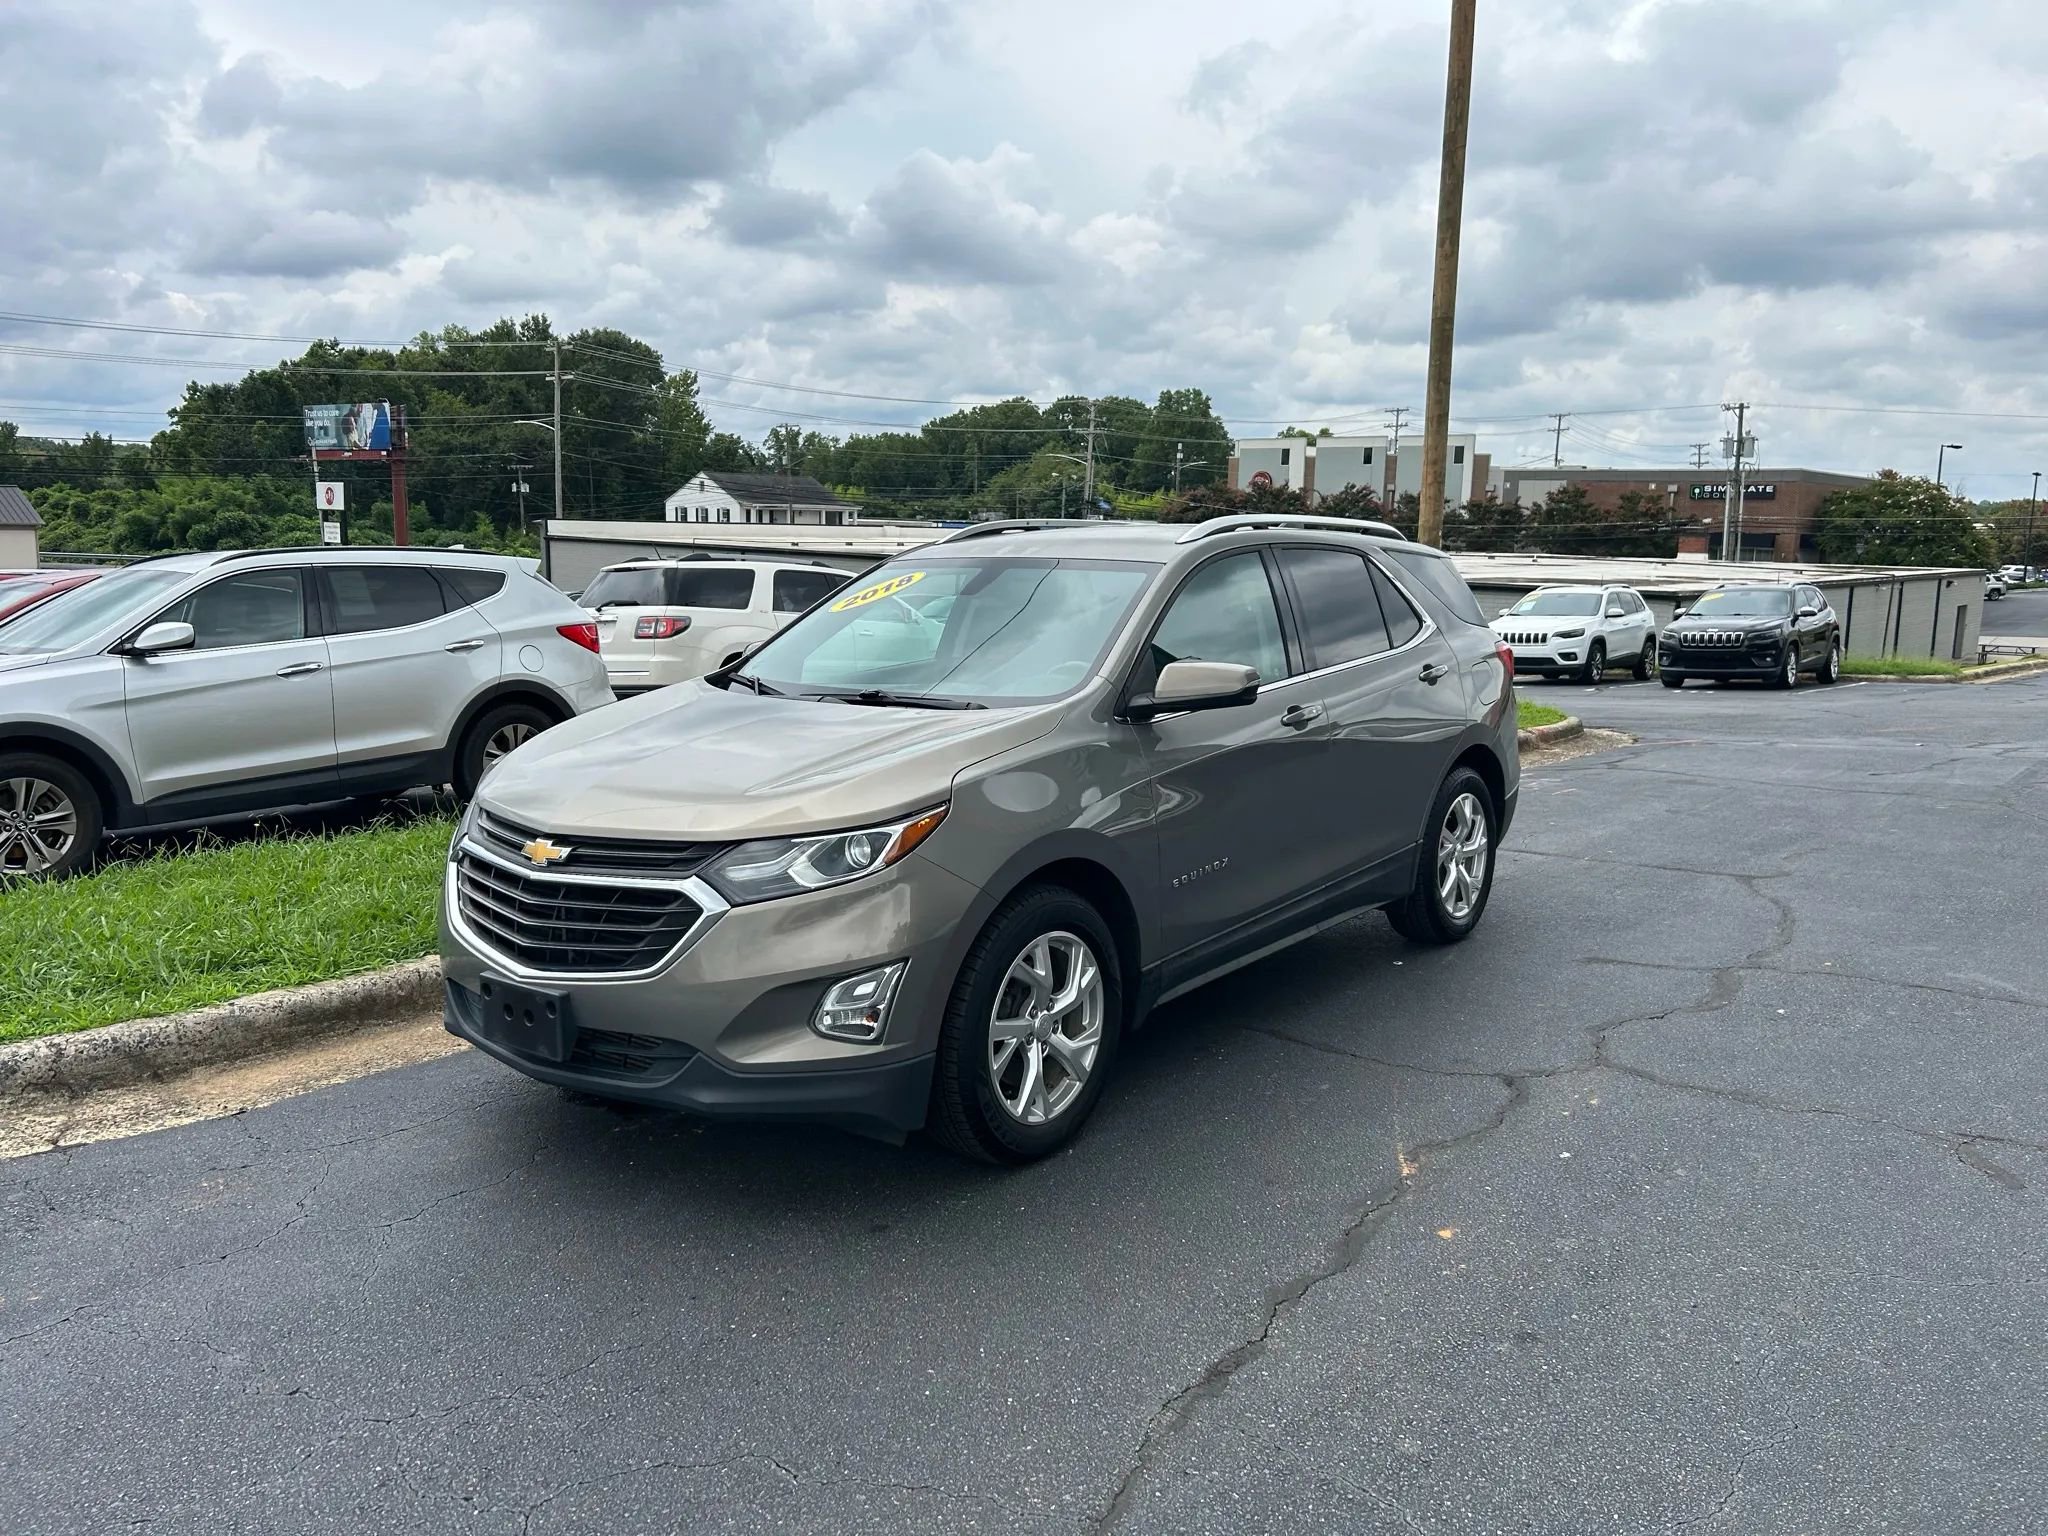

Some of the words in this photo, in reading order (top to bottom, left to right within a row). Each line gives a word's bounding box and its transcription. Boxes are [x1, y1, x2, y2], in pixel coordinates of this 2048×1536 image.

[314, 420, 323, 428] you
[840, 575, 915, 609] 2018
[1172, 857, 1229, 887] EQUINOX
